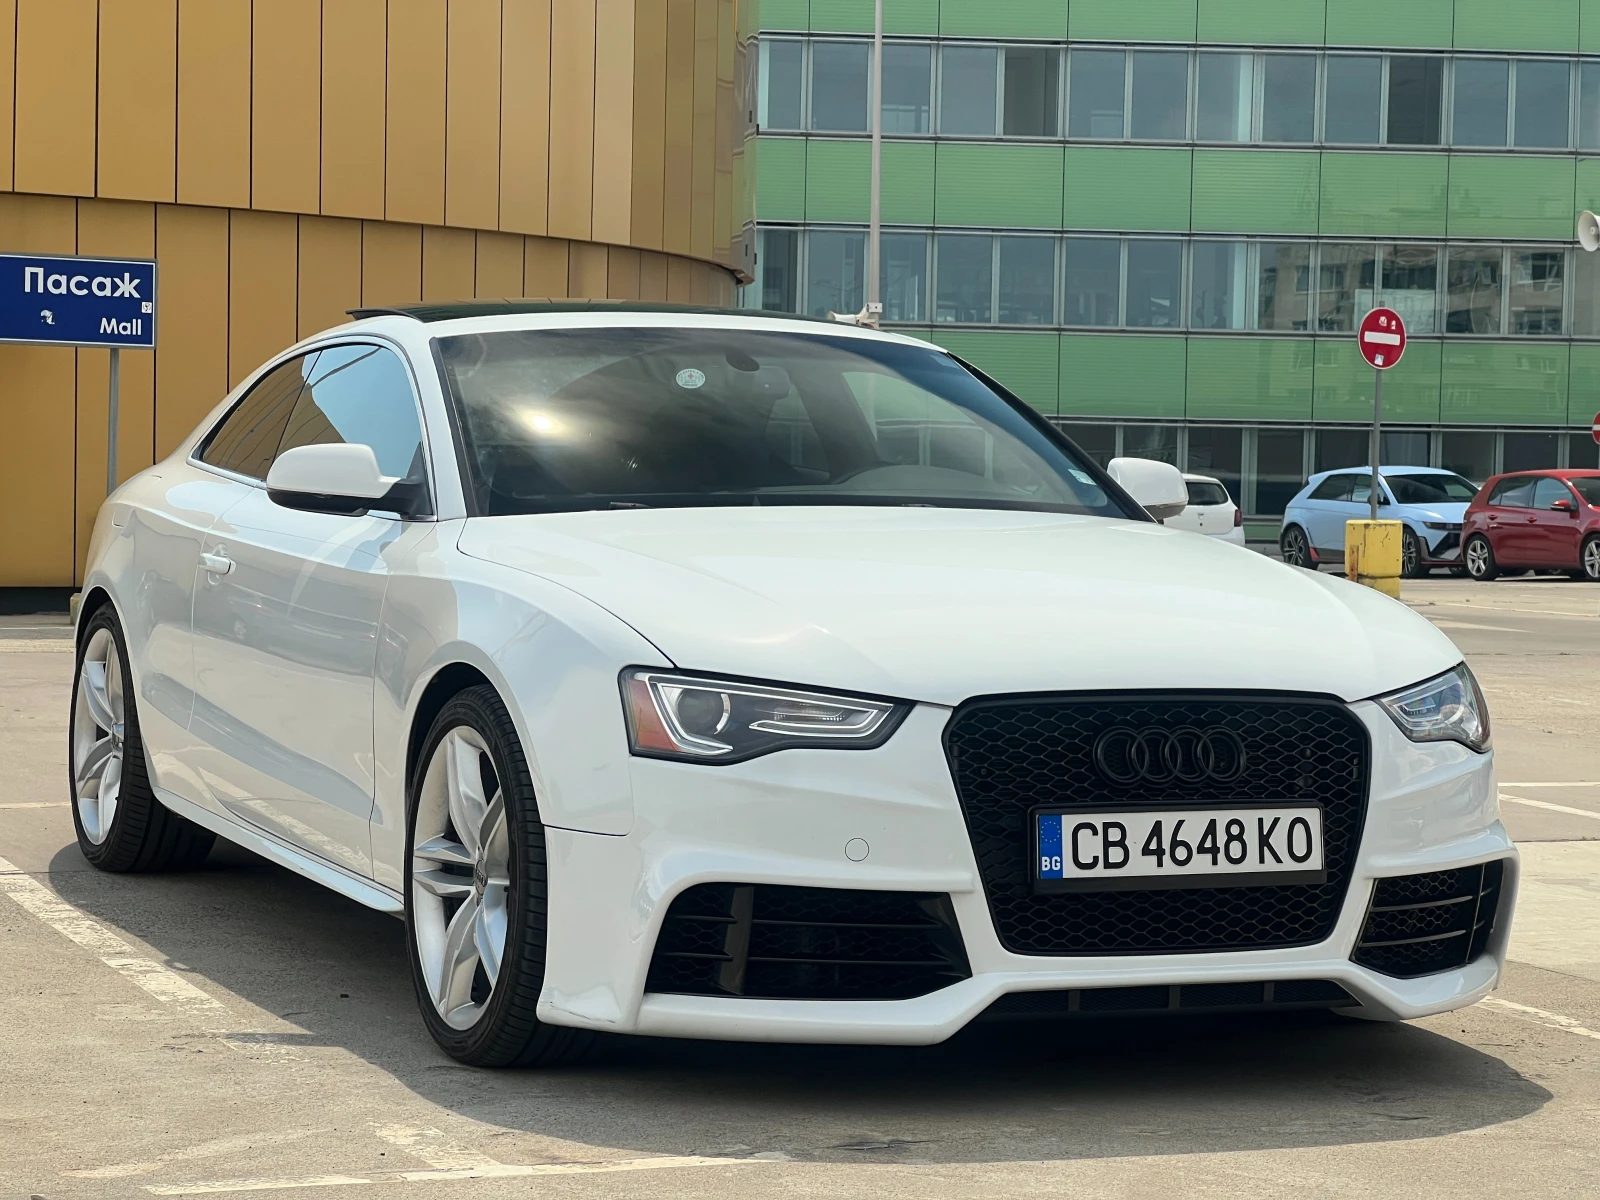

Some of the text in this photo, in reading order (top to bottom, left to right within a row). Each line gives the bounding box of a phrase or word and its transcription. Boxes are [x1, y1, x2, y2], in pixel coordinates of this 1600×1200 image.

[24, 266, 141, 299] Пасаж
[99, 317, 142, 336] Mall
[1071, 821, 1130, 870] CB
[1141, 818, 1248, 868] 4648
[1041, 855, 1061, 871] BG
